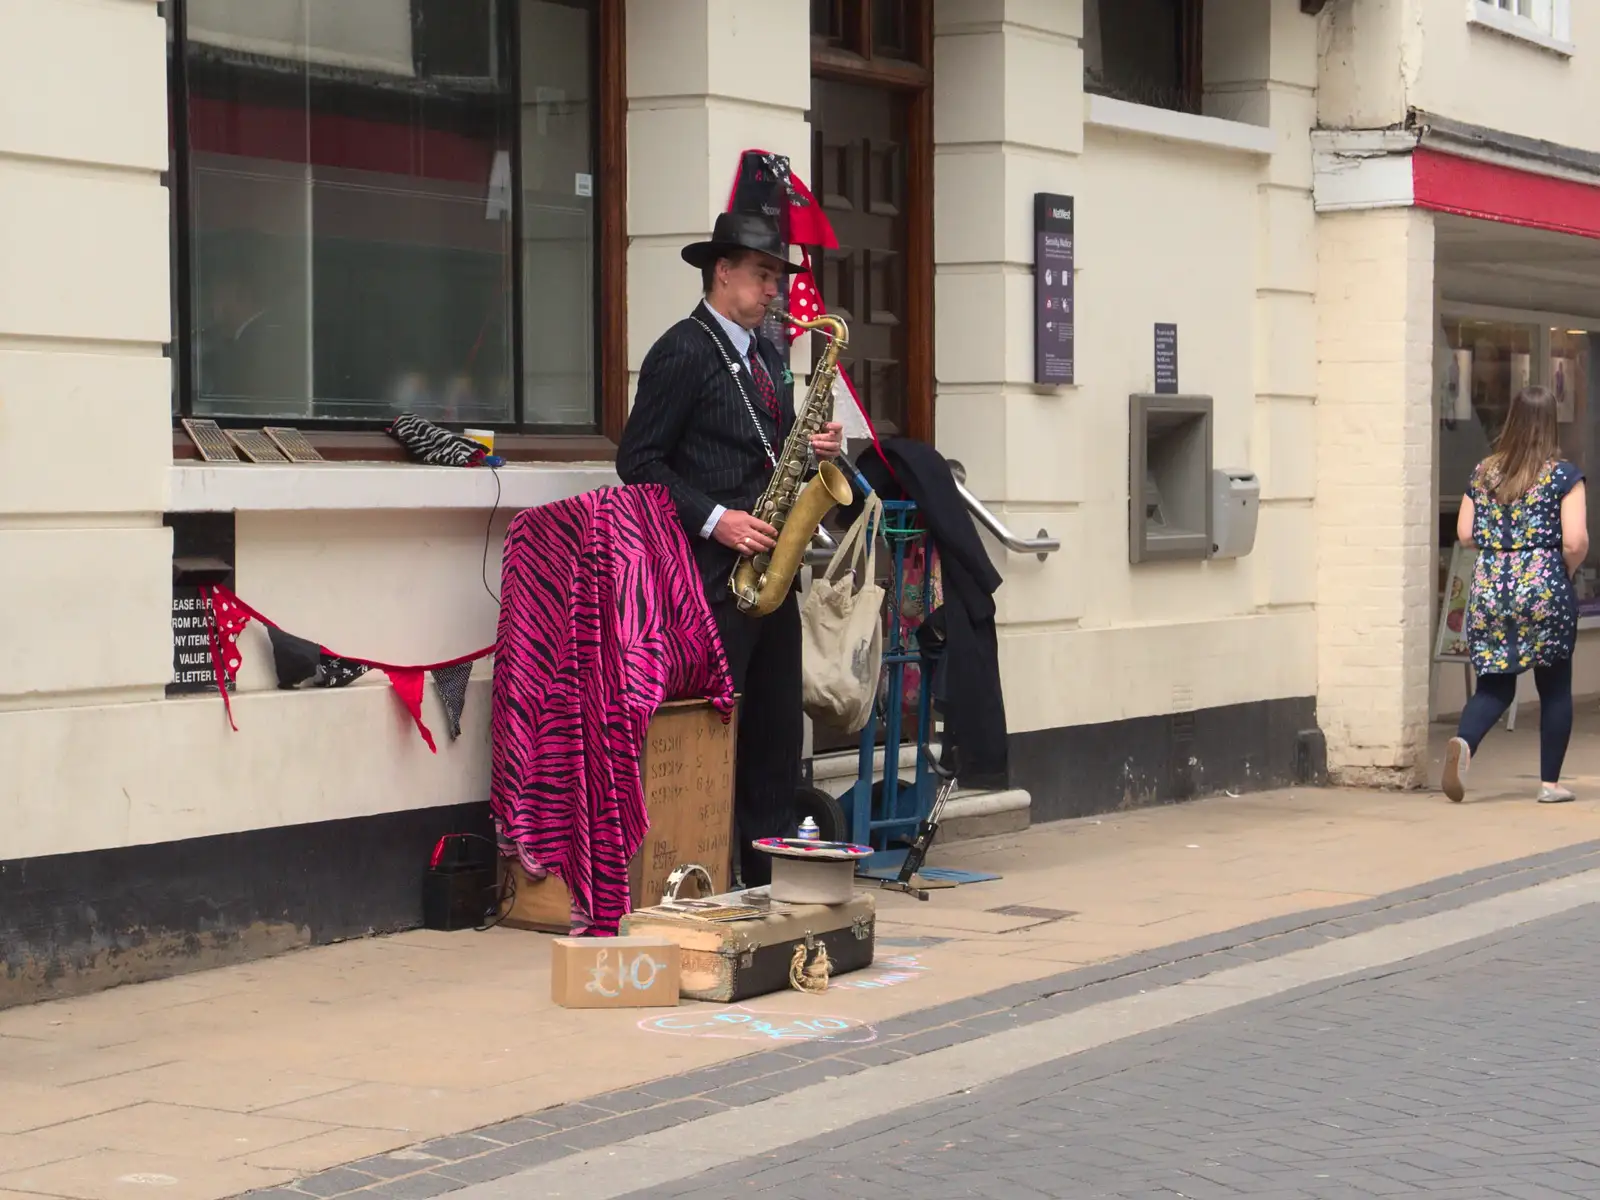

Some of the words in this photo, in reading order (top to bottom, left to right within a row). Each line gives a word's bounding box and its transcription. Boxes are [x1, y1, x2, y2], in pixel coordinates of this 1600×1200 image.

[1052, 207, 1071, 220] NatWest
[172, 599, 194, 610] EASE
[172, 617, 191, 629] ROM
[173, 635, 187, 647] NY
[188, 634, 210, 646] ITEMS
[179, 652, 205, 664] VALUE
[182, 670, 211, 683] LETTER
[585, 948, 657, 997] £10
